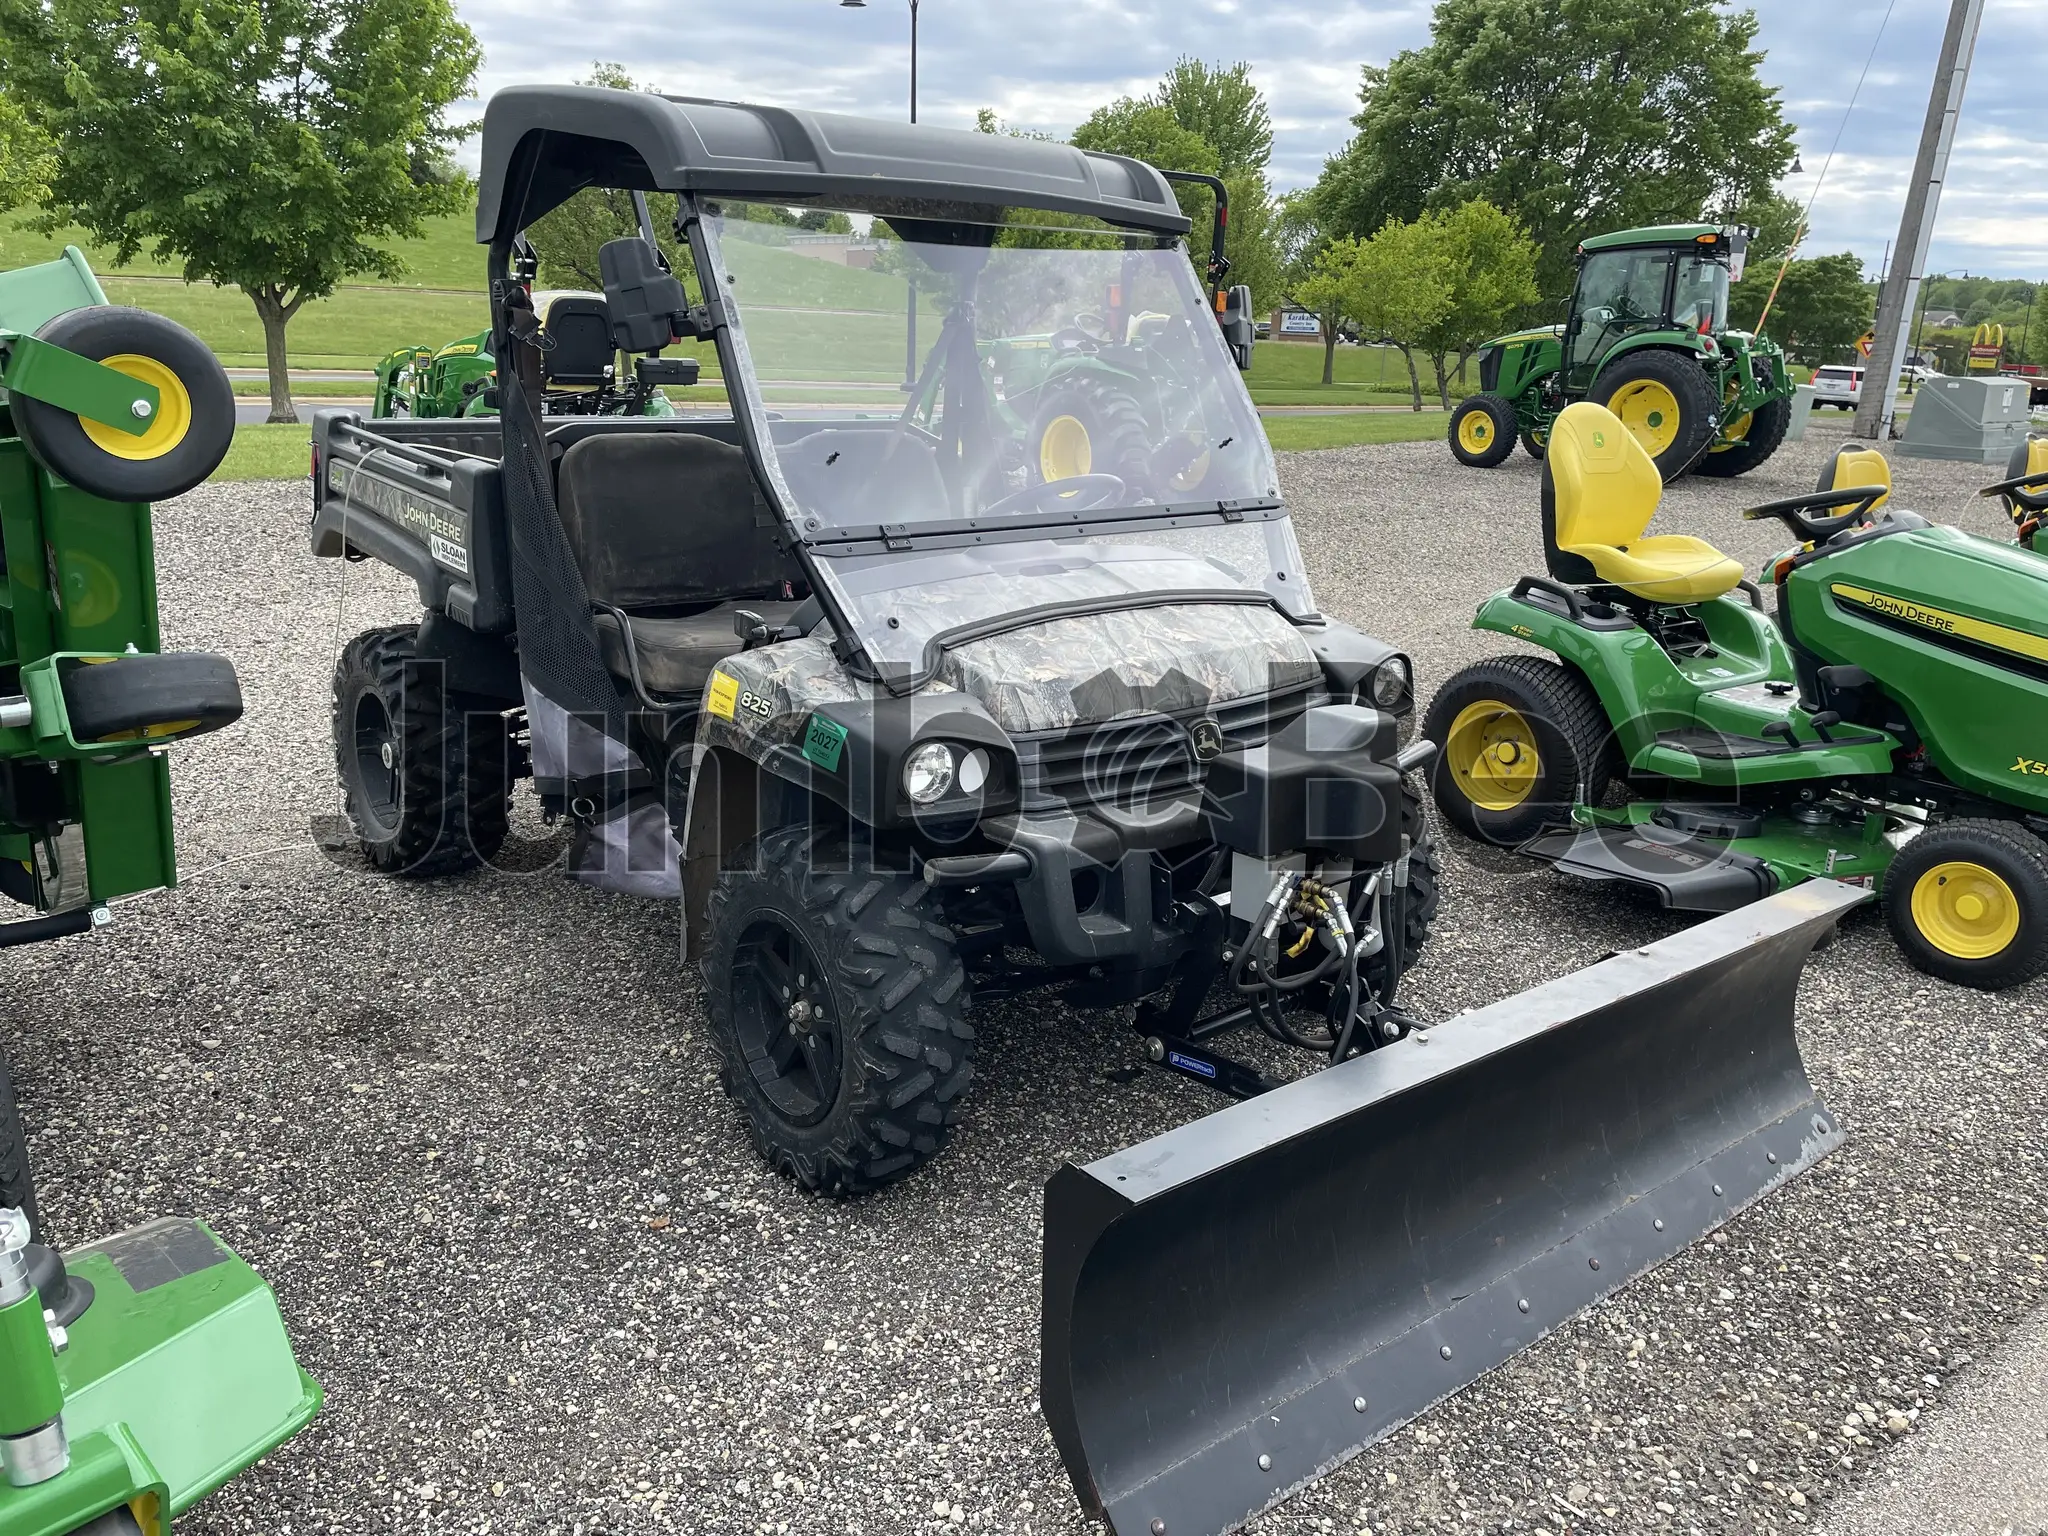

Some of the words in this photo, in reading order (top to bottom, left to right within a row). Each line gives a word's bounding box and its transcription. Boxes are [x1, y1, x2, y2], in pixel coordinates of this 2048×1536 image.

[404, 502, 428, 528] JOHN
[430, 512, 461, 544] DEERE
[440, 542, 466, 563] SLOAN
[441, 553, 466, 569] IMPLEMENT
[1865, 594, 1903, 616] JOHN
[1905, 606, 1955, 632] DEERE
[741, 690, 773, 719] 825i
[810, 728, 839, 752] 2027
